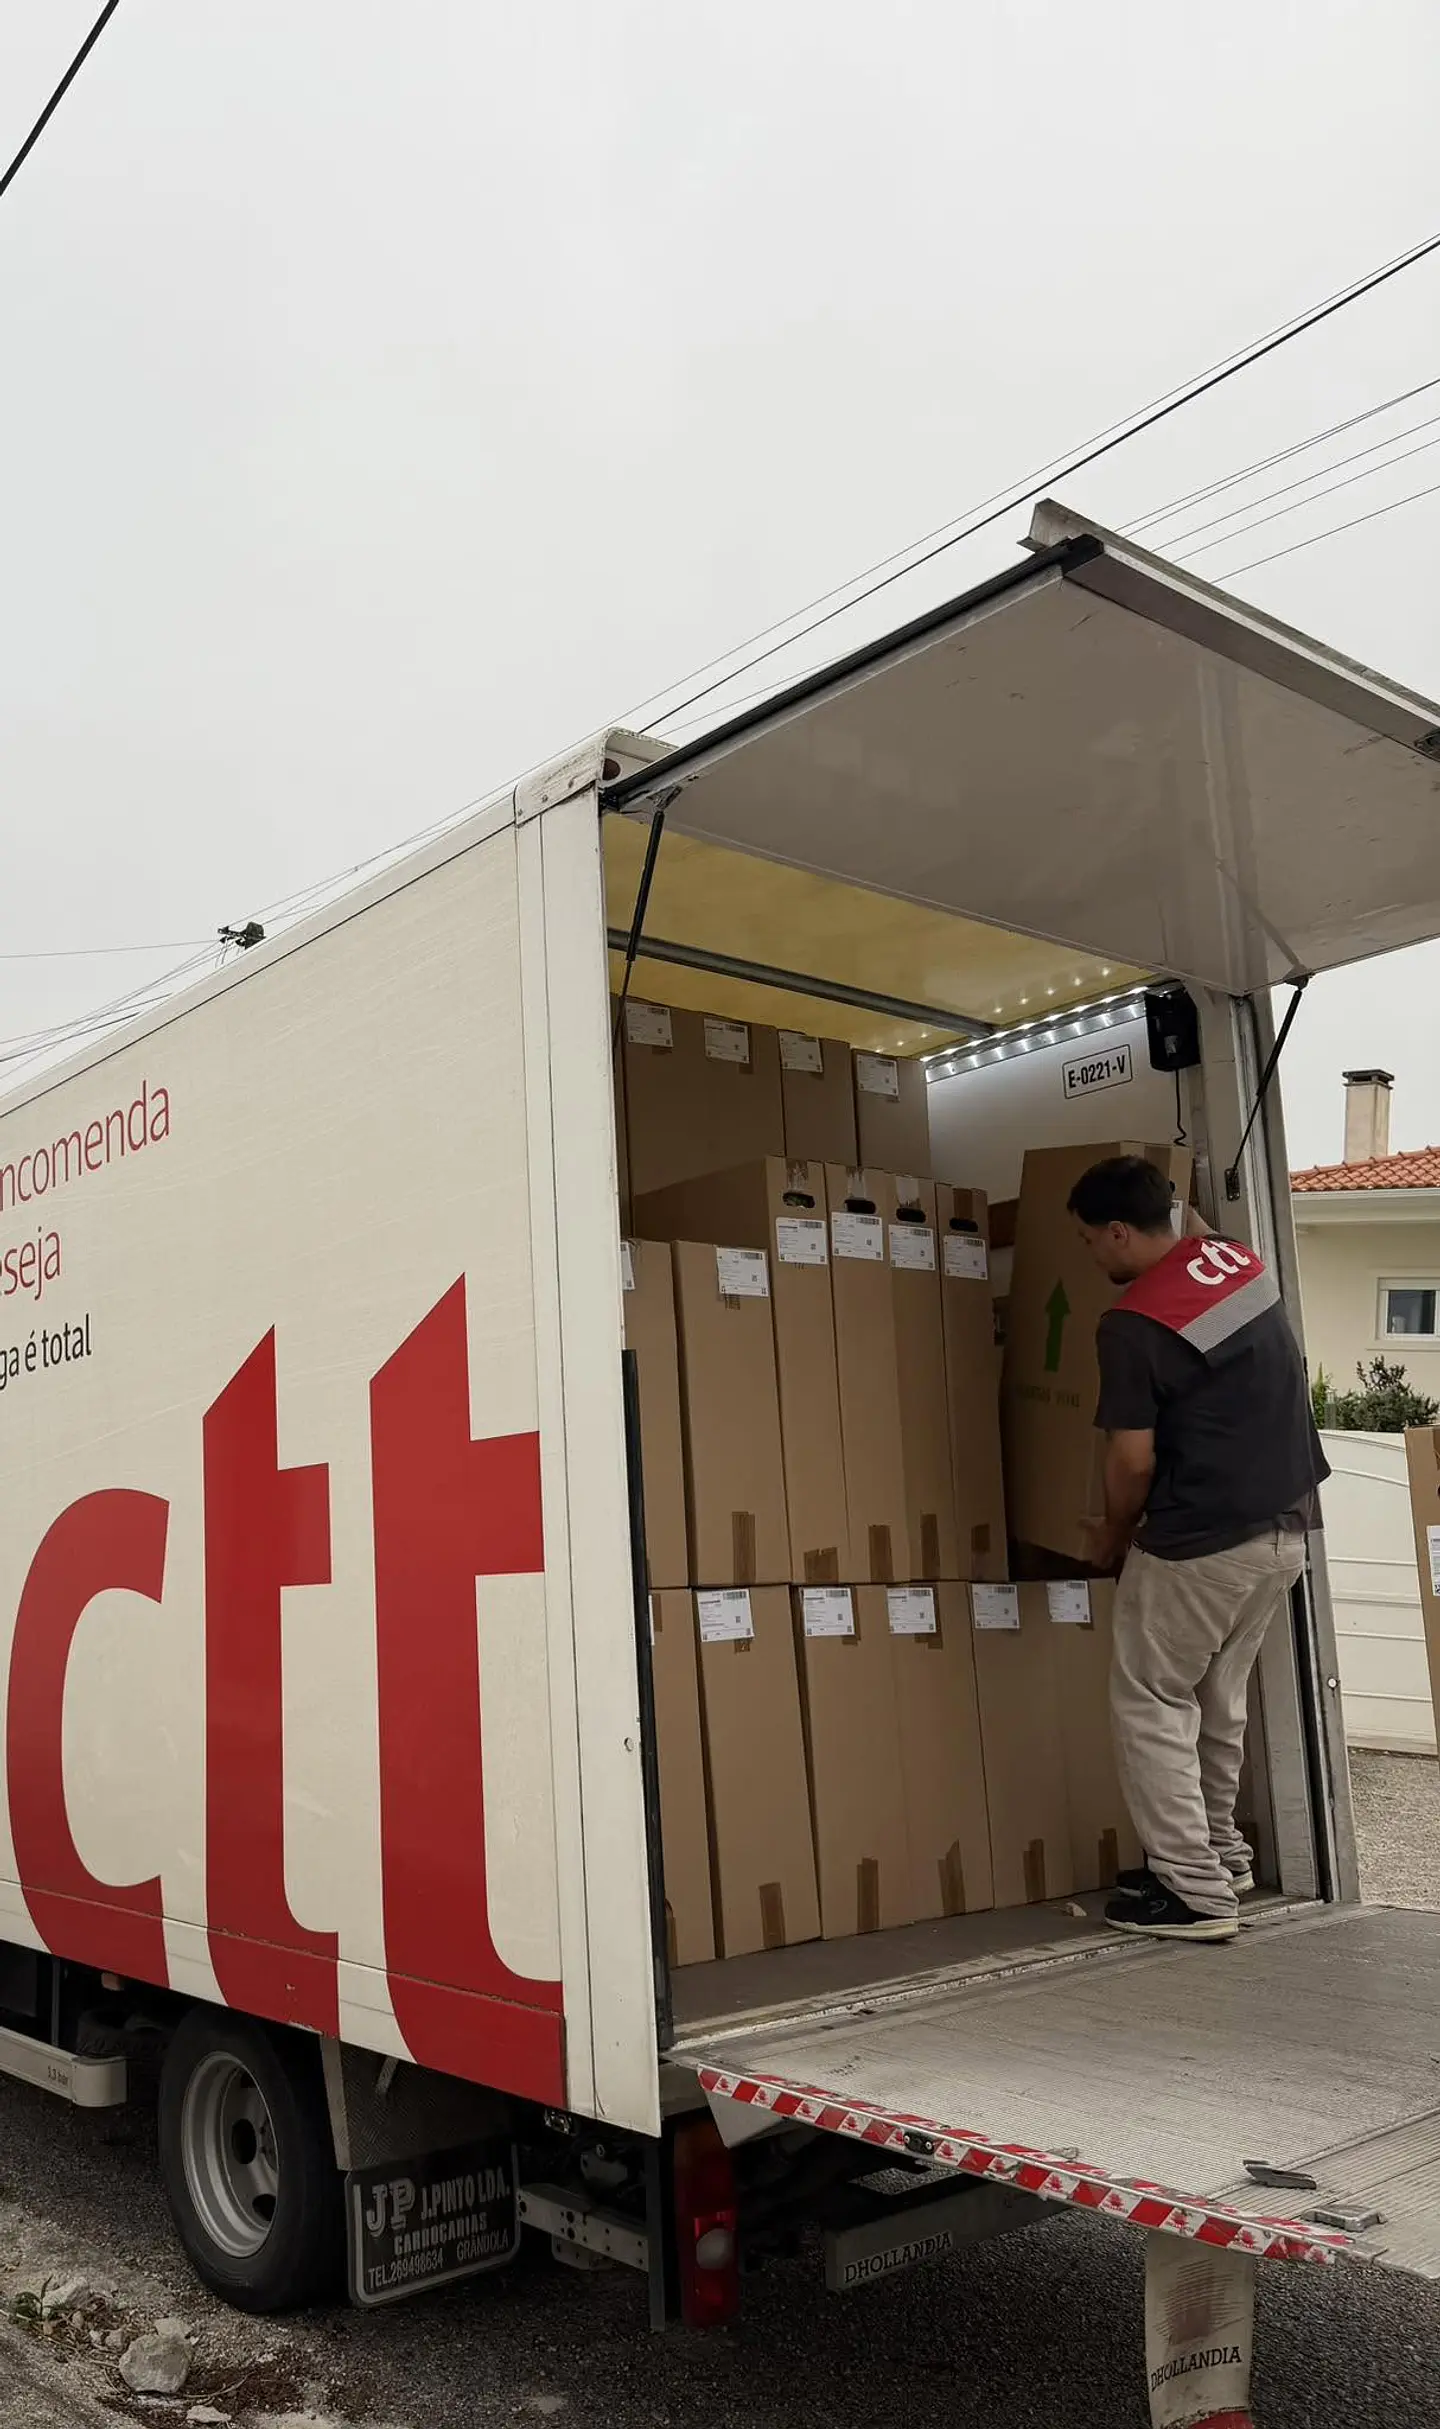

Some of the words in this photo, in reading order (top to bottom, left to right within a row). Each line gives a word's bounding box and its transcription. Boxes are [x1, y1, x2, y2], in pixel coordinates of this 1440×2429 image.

[1068, 1055, 1125, 1088] E-0221-V
[0, 1226, 61, 1300] seja
[1187, 1240, 1251, 1285] ctt
[25, 1330, 36, 1372] é
[42, 1313, 92, 1368] total
[6, 1272, 566, 2108] ctt
[366, 2177, 416, 2238] JP
[844, 2231, 952, 2283] DHOLLANDIA
[1151, 2346, 1242, 2392] DHOLLANDIA
